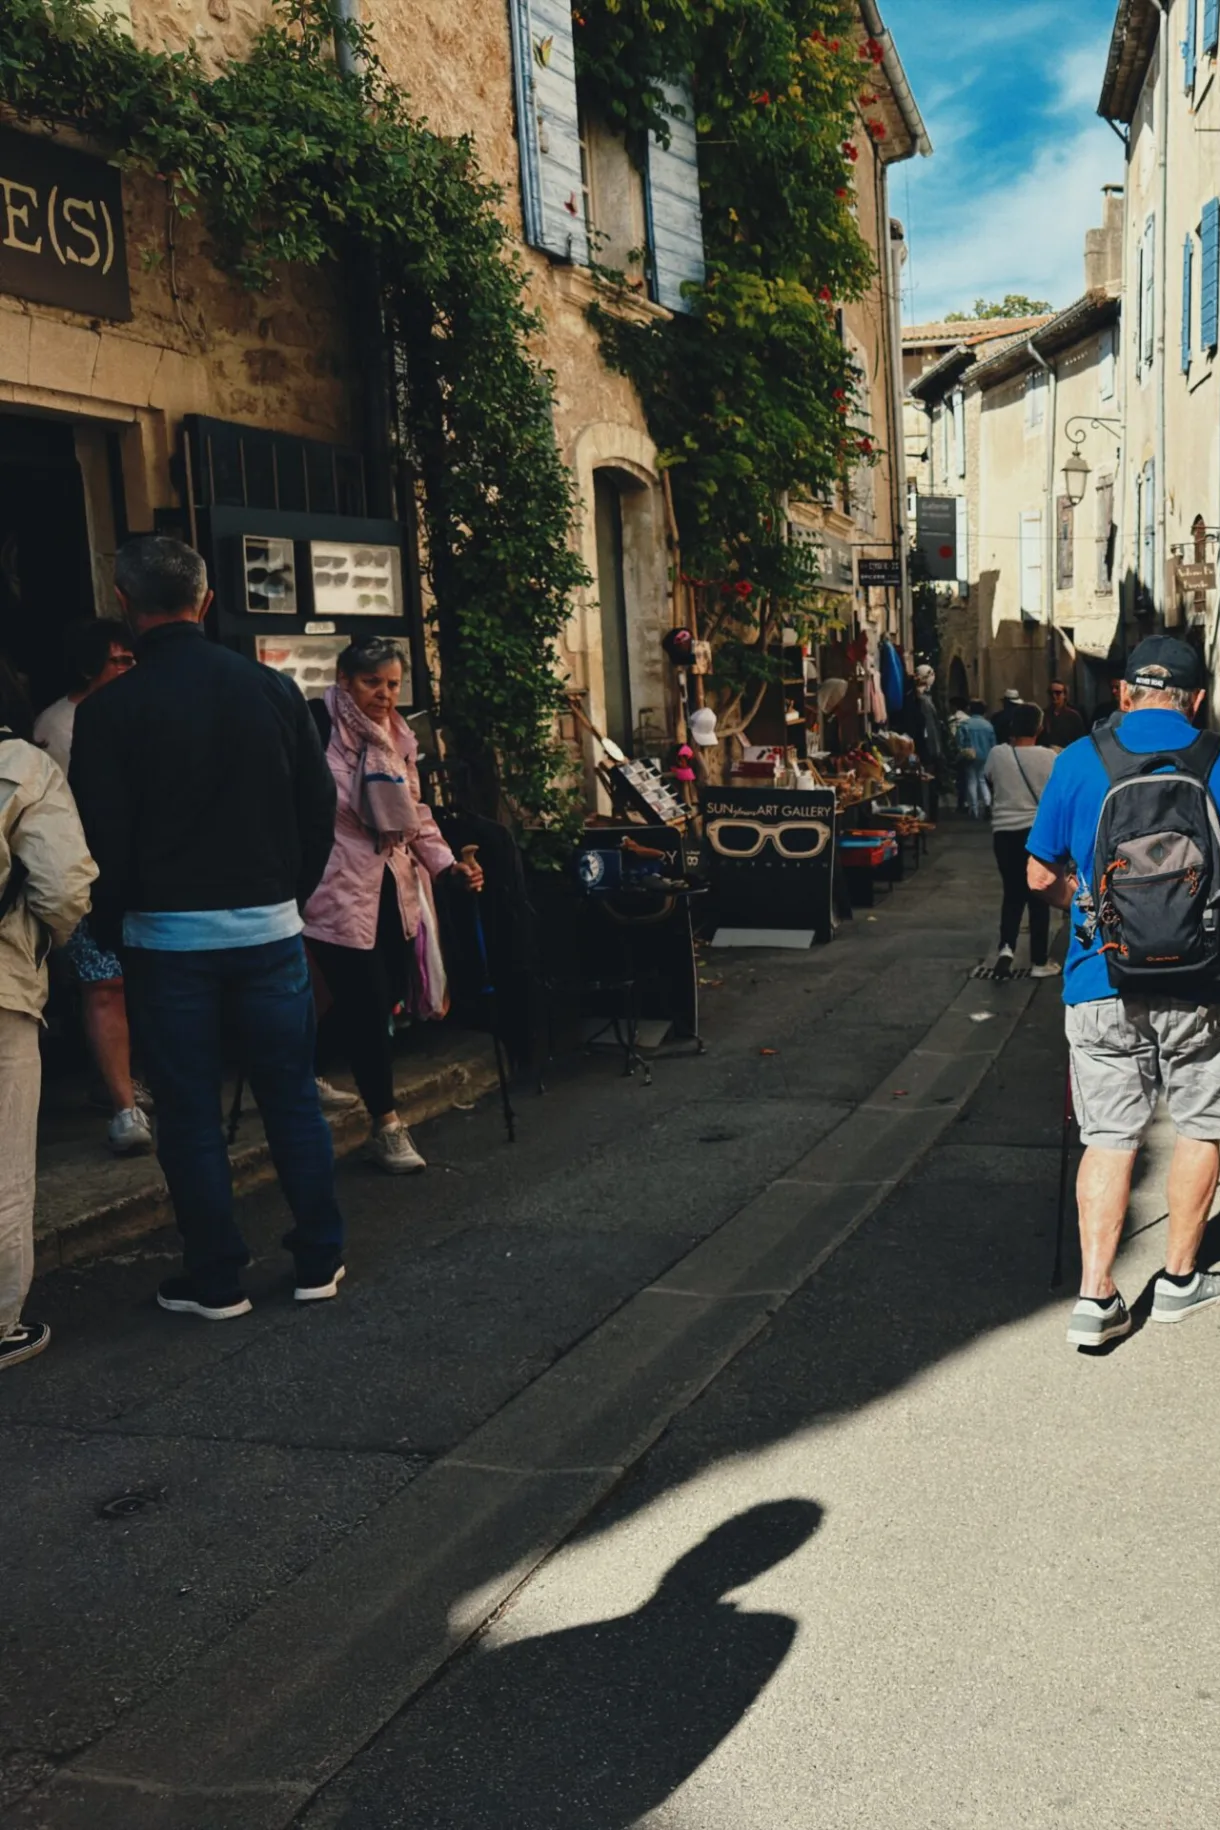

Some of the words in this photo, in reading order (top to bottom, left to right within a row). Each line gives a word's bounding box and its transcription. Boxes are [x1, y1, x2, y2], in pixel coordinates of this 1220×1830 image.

[706, 802, 734, 815] SUN
[756, 804, 780, 817] ART
[781, 805, 832, 818] GALLERY
